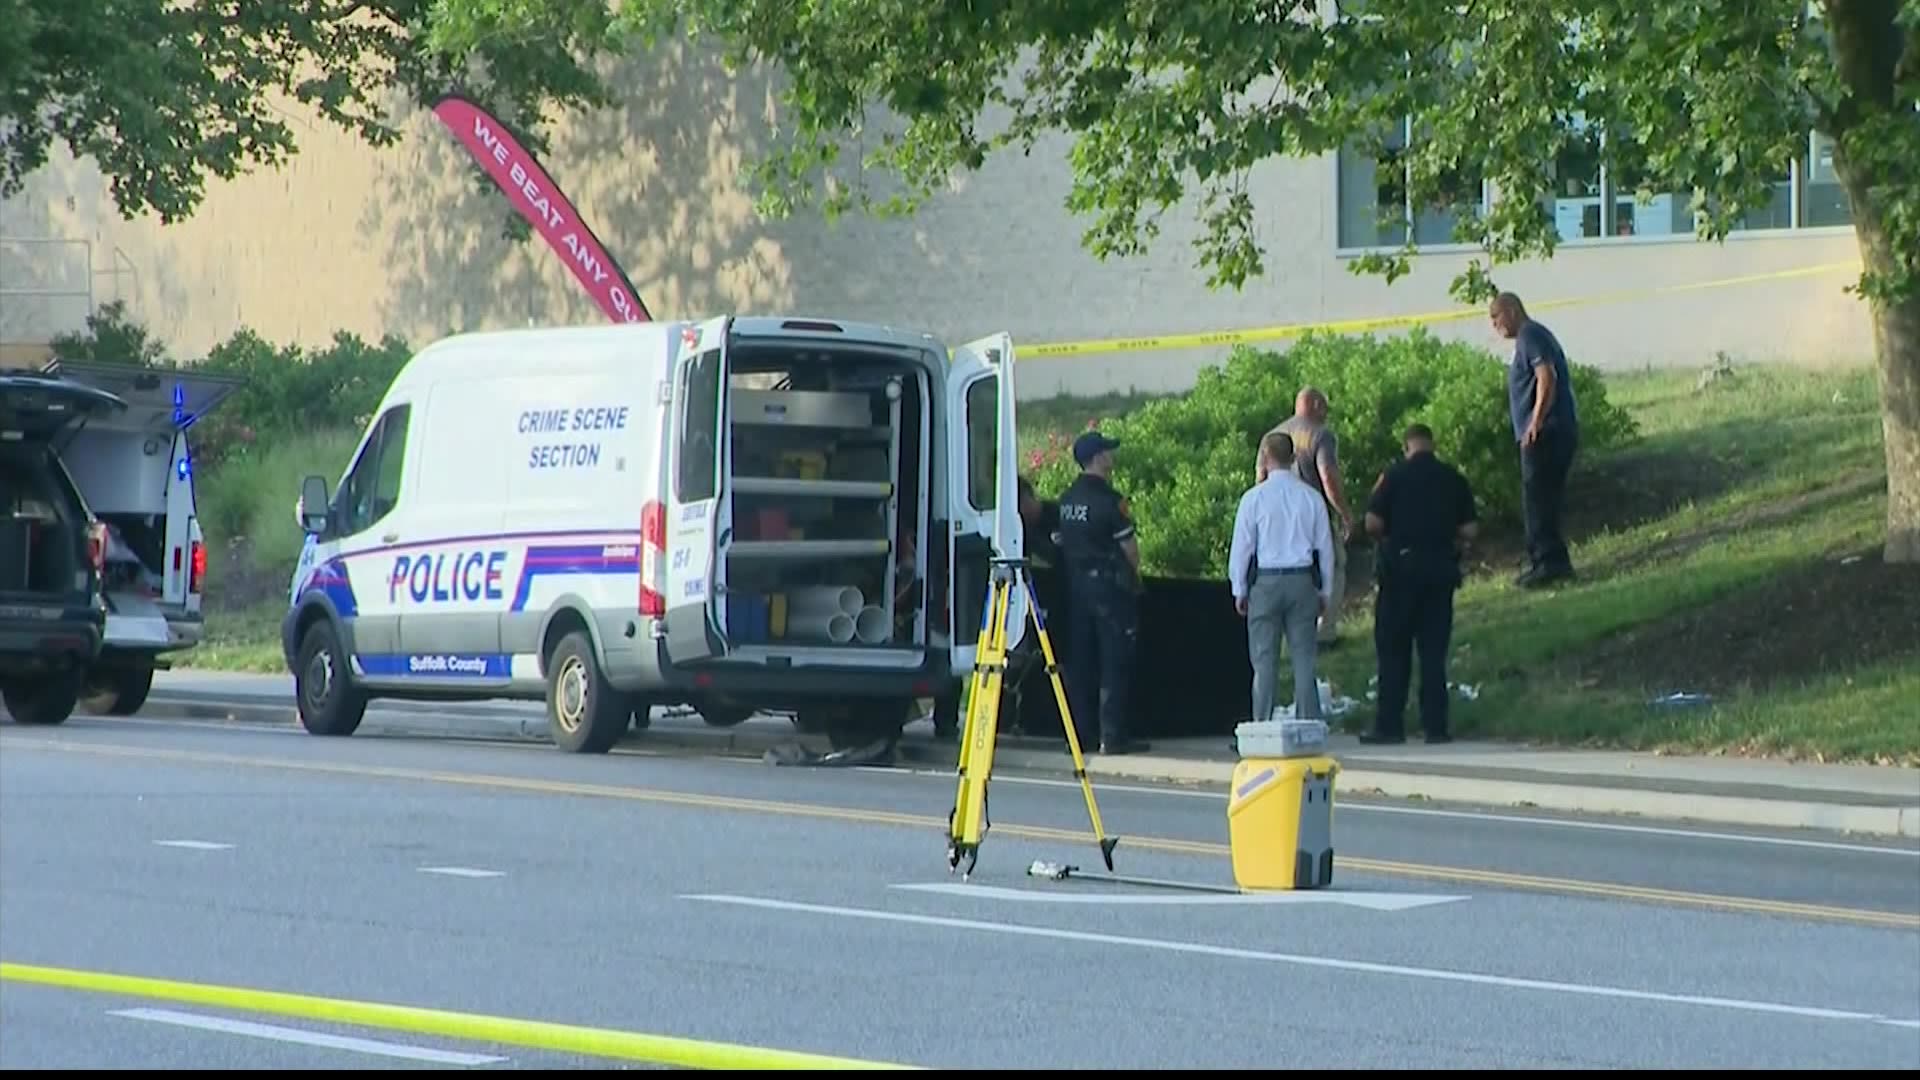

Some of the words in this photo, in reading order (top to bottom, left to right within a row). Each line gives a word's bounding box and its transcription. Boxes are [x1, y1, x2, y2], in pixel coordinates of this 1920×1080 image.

[474, 116, 510, 165] WE
[509, 162, 564, 229] BEAT
[562, 232, 608, 283] ANY
[518, 409, 569, 433] CRIME
[572, 407, 628, 430] SCENE
[528, 443, 600, 468] SECTION
[390, 551, 507, 603] POLICE
[409, 656, 447, 672] Suffolk
[448, 655, 487, 675] County
